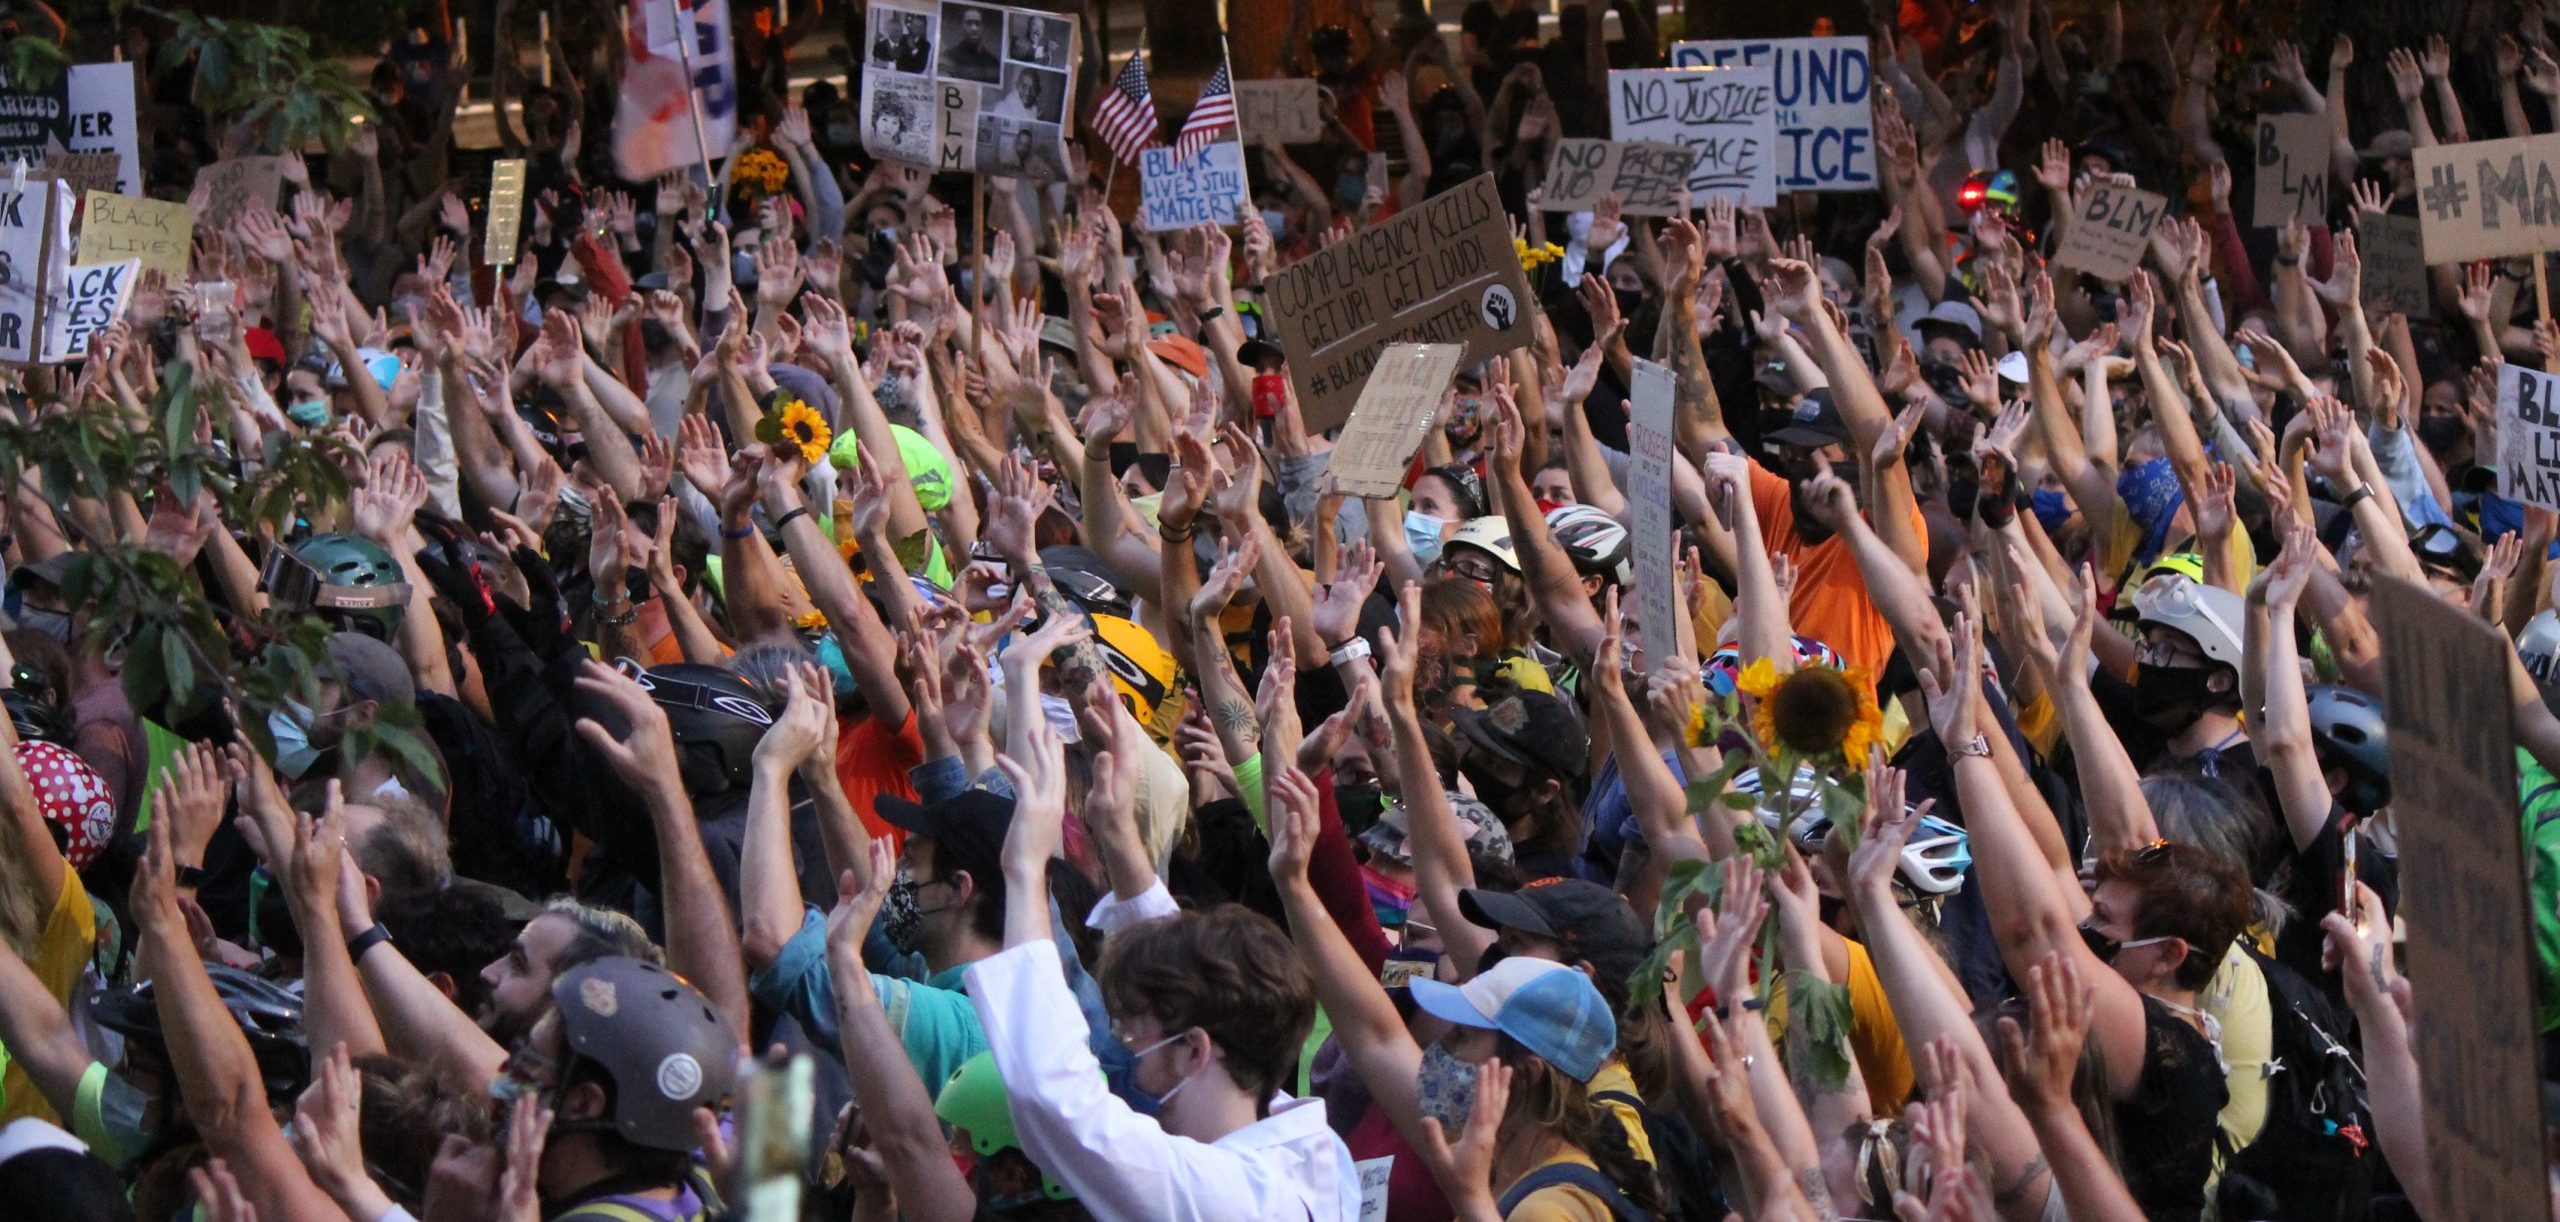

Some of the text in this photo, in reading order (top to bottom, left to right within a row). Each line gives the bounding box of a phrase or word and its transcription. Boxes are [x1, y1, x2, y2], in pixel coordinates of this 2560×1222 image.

[1622, 79, 1668, 120] NO
[1674, 77, 1771, 122] JUSTICE
[942, 86, 964, 170] BLM
[1147, 147, 1213, 178] BLCK
[1558, 145, 1607, 170] NO
[1776, 127, 1871, 186] ICE
[2259, 121, 2325, 217] BLM
[1143, 170, 1240, 198] LIVES STILL
[1551, 172, 1596, 201] NO
[92, 198, 169, 235] BLACK
[2085, 189, 2159, 237] BLM
[108, 235, 181, 254] LIVES
[1275, 180, 1491, 318] COMPLACENCY KILLS
[67, 297, 115, 326] ES
[1302, 234, 1489, 350] GET UP! GET LOUD!
[1635, 422, 1668, 463] ROSES
